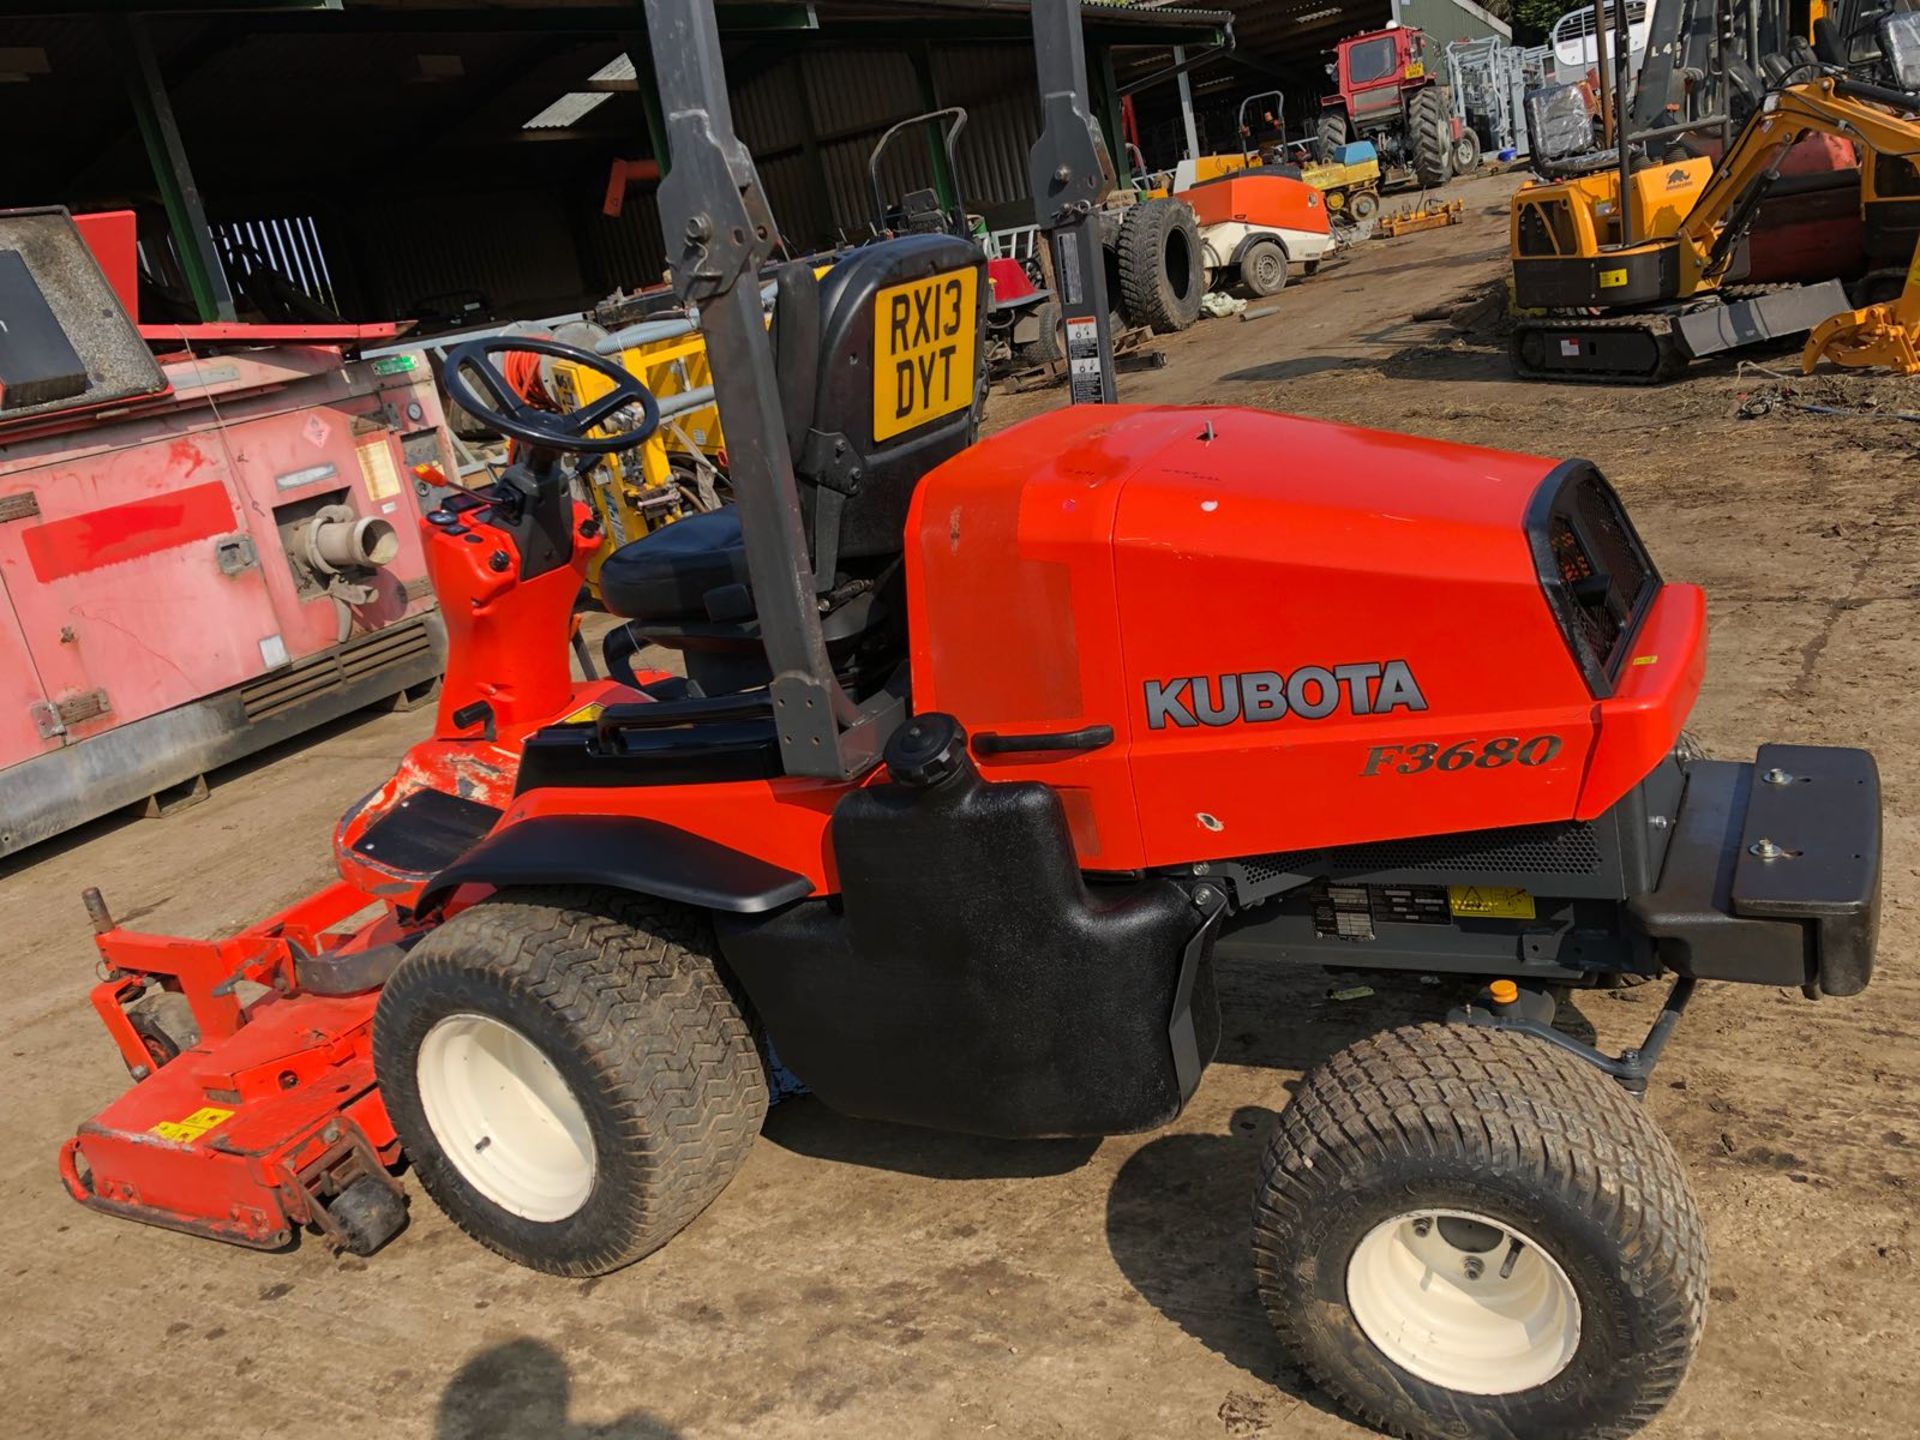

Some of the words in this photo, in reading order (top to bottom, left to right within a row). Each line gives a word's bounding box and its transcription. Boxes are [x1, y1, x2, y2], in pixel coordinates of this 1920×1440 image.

[890, 279, 962, 356] RX13
[896, 345, 957, 420] DYT
[1144, 659, 1428, 729] KUBOTA
[1359, 734, 1562, 777] F3680
